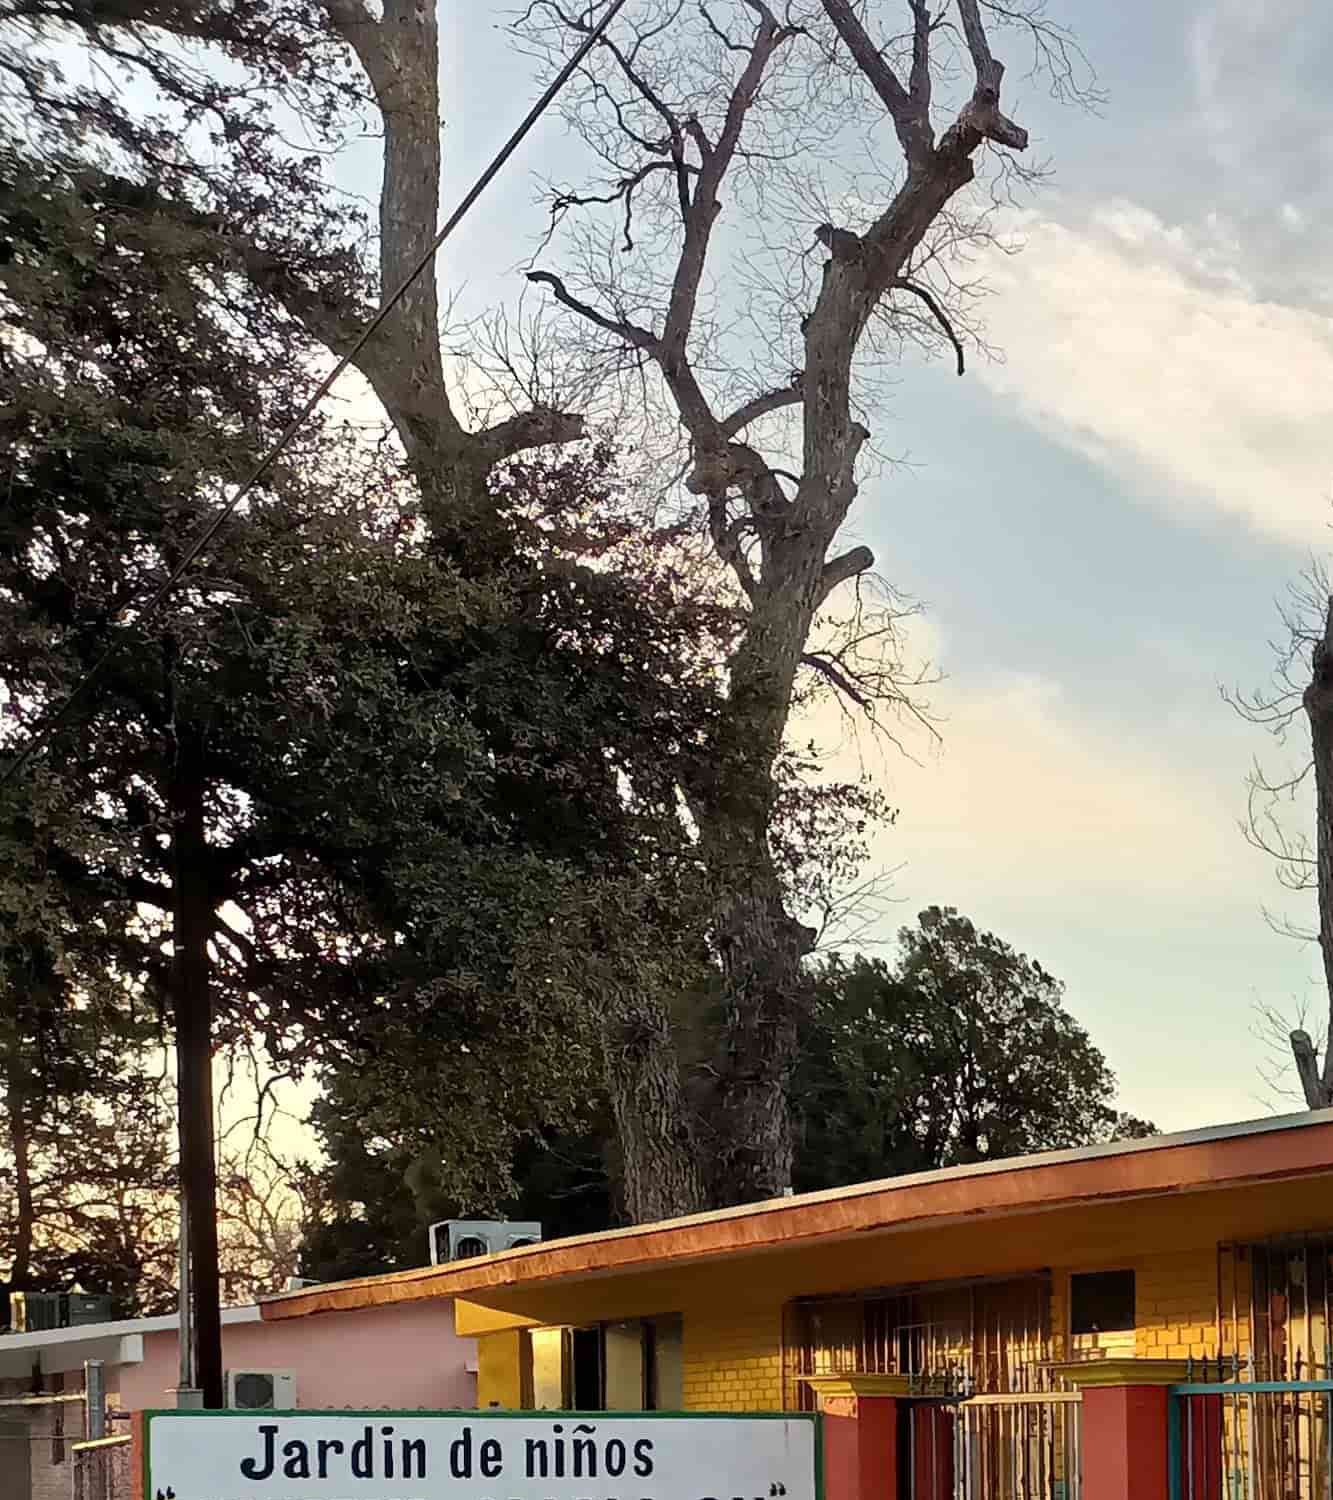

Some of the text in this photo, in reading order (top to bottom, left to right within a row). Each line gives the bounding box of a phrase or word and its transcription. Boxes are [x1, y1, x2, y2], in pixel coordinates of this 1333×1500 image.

[240, 1423, 654, 1480] Jardin de niños
